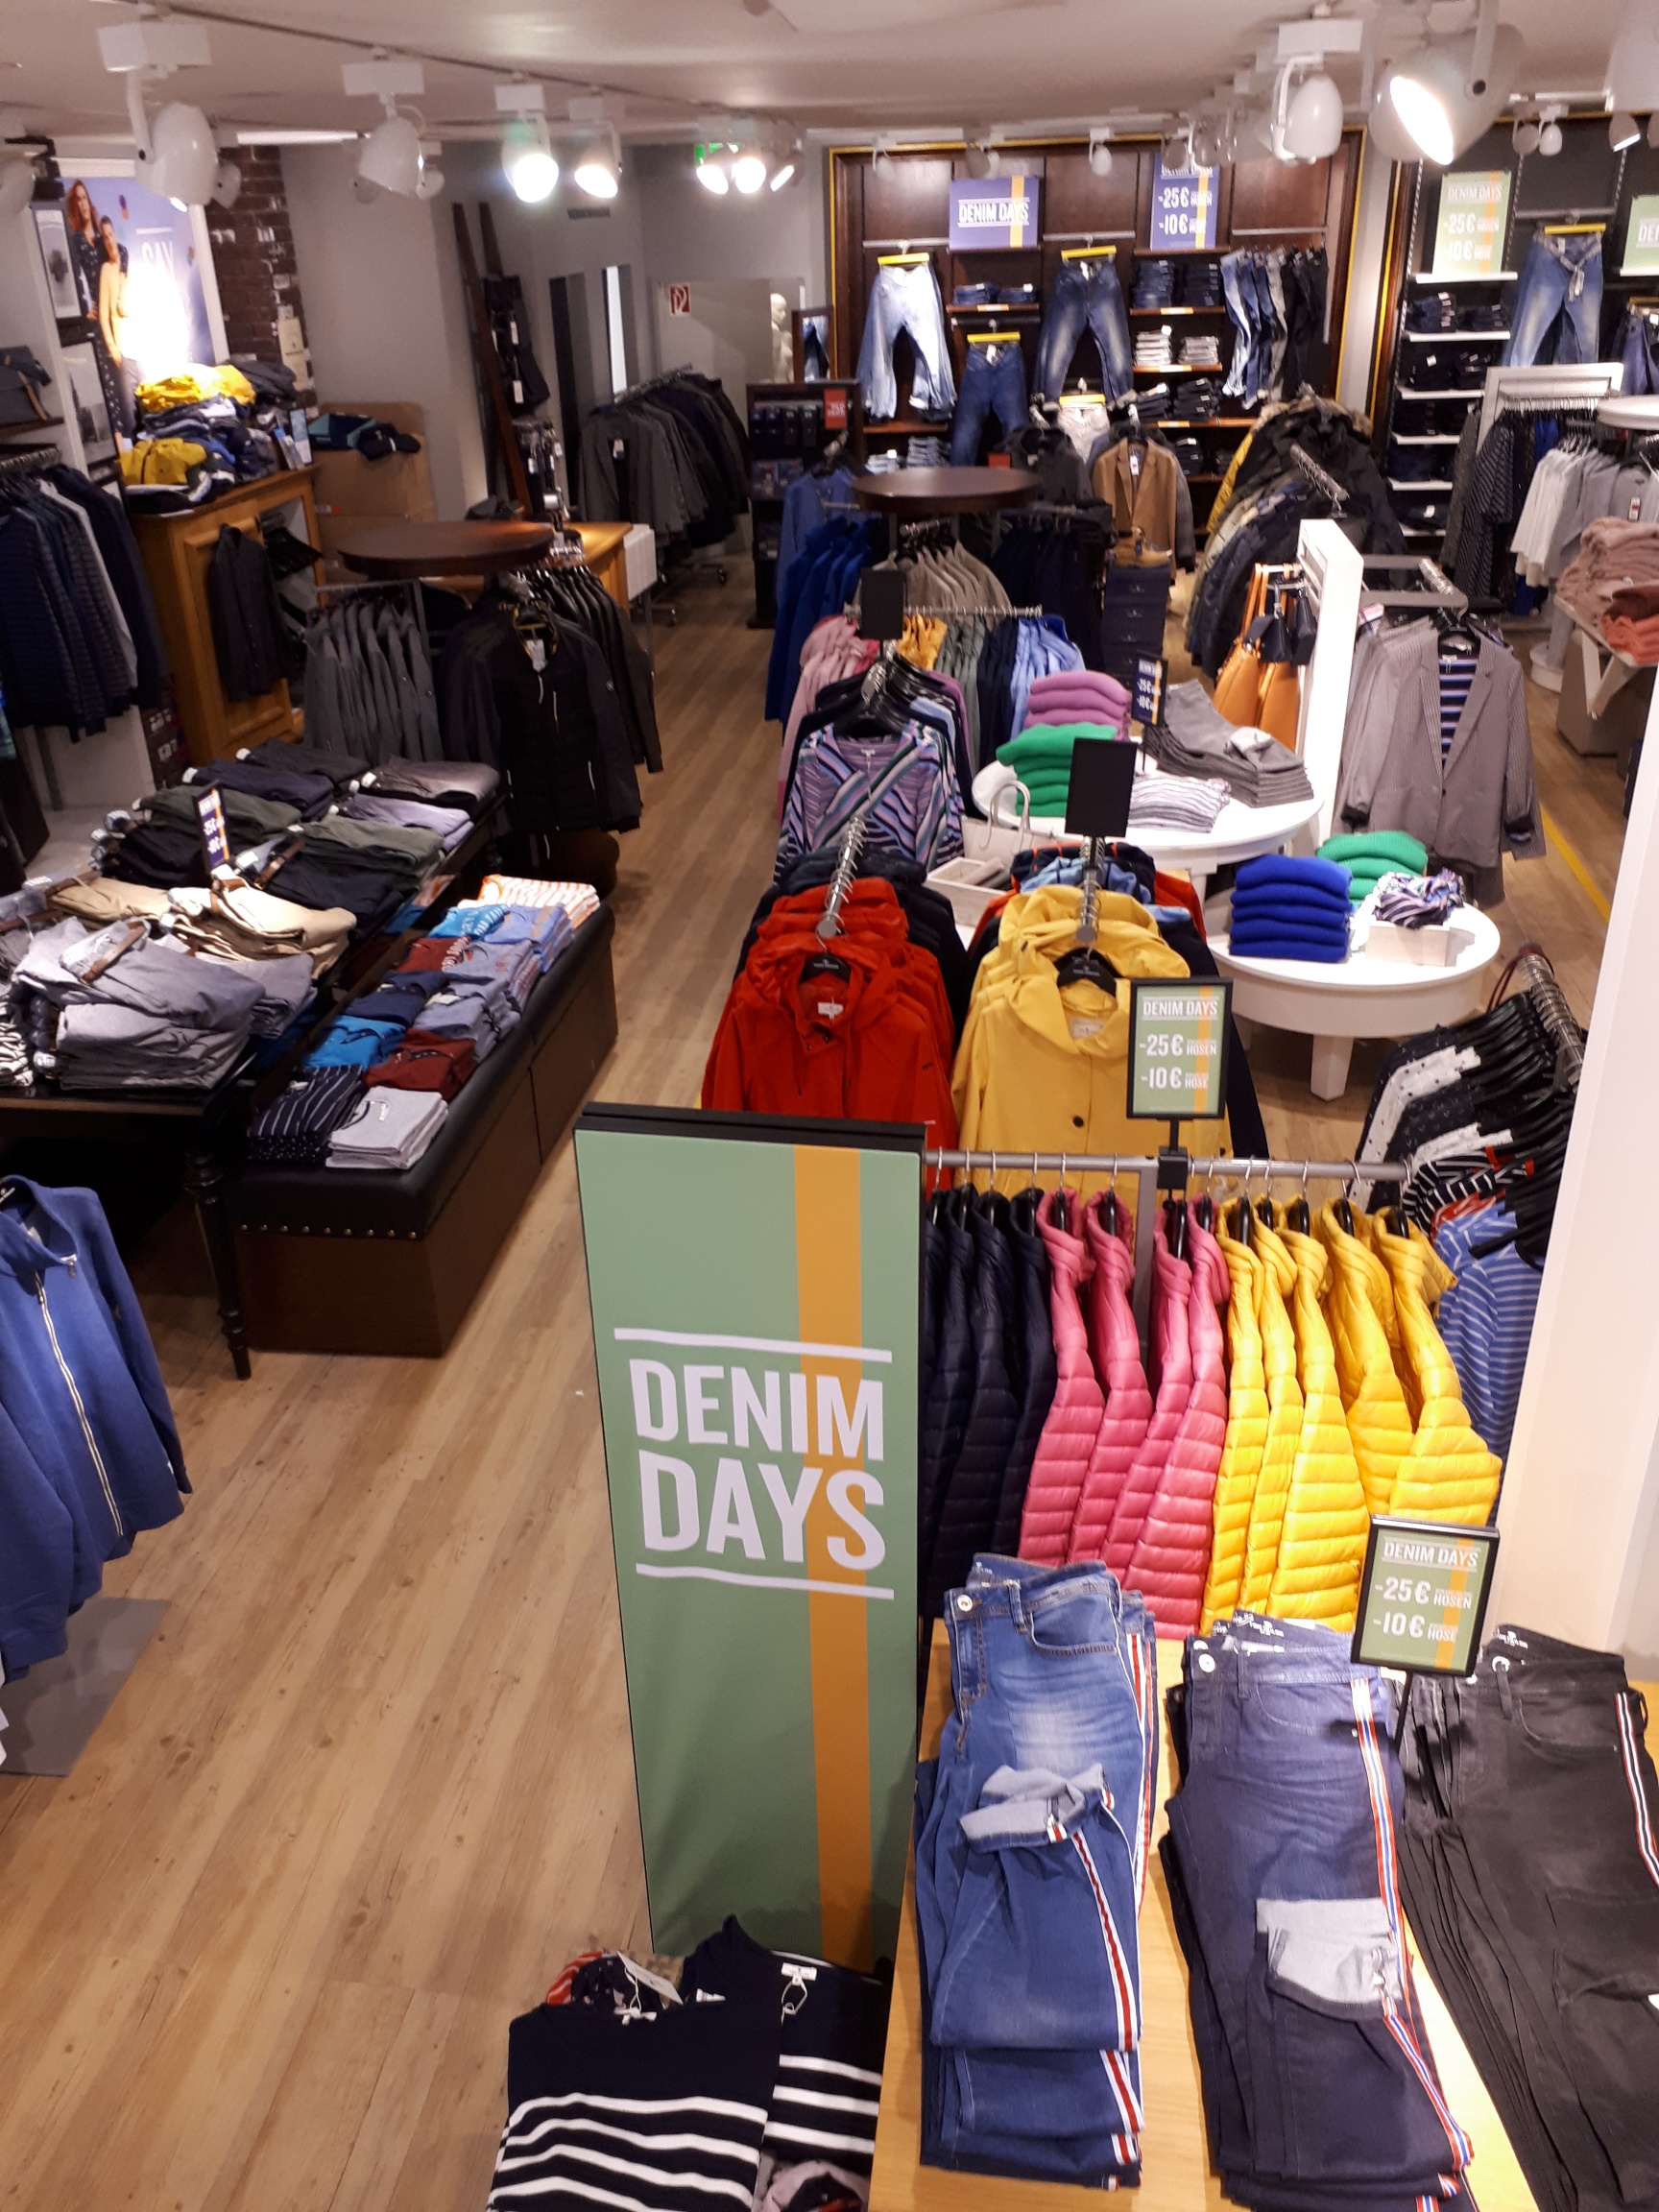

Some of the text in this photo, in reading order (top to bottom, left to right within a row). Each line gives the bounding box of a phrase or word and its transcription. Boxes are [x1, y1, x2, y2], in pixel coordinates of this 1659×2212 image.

[958, 202, 1029, 223] DENIM DAYS
[1142, 999, 1218, 1016] DENIM DAYS
[1139, 1033, 1184, 1056] -25€
[1141, 1066, 1182, 1089] -10€
[629, 1358, 884, 1461] DENIM
[638, 1449, 885, 1571] DAYS
[1383, 1542, 1479, 1567] DENIM DAYS
[1374, 1576, 1431, 1604] -25€
[1373, 1611, 1426, 1638] -10€
